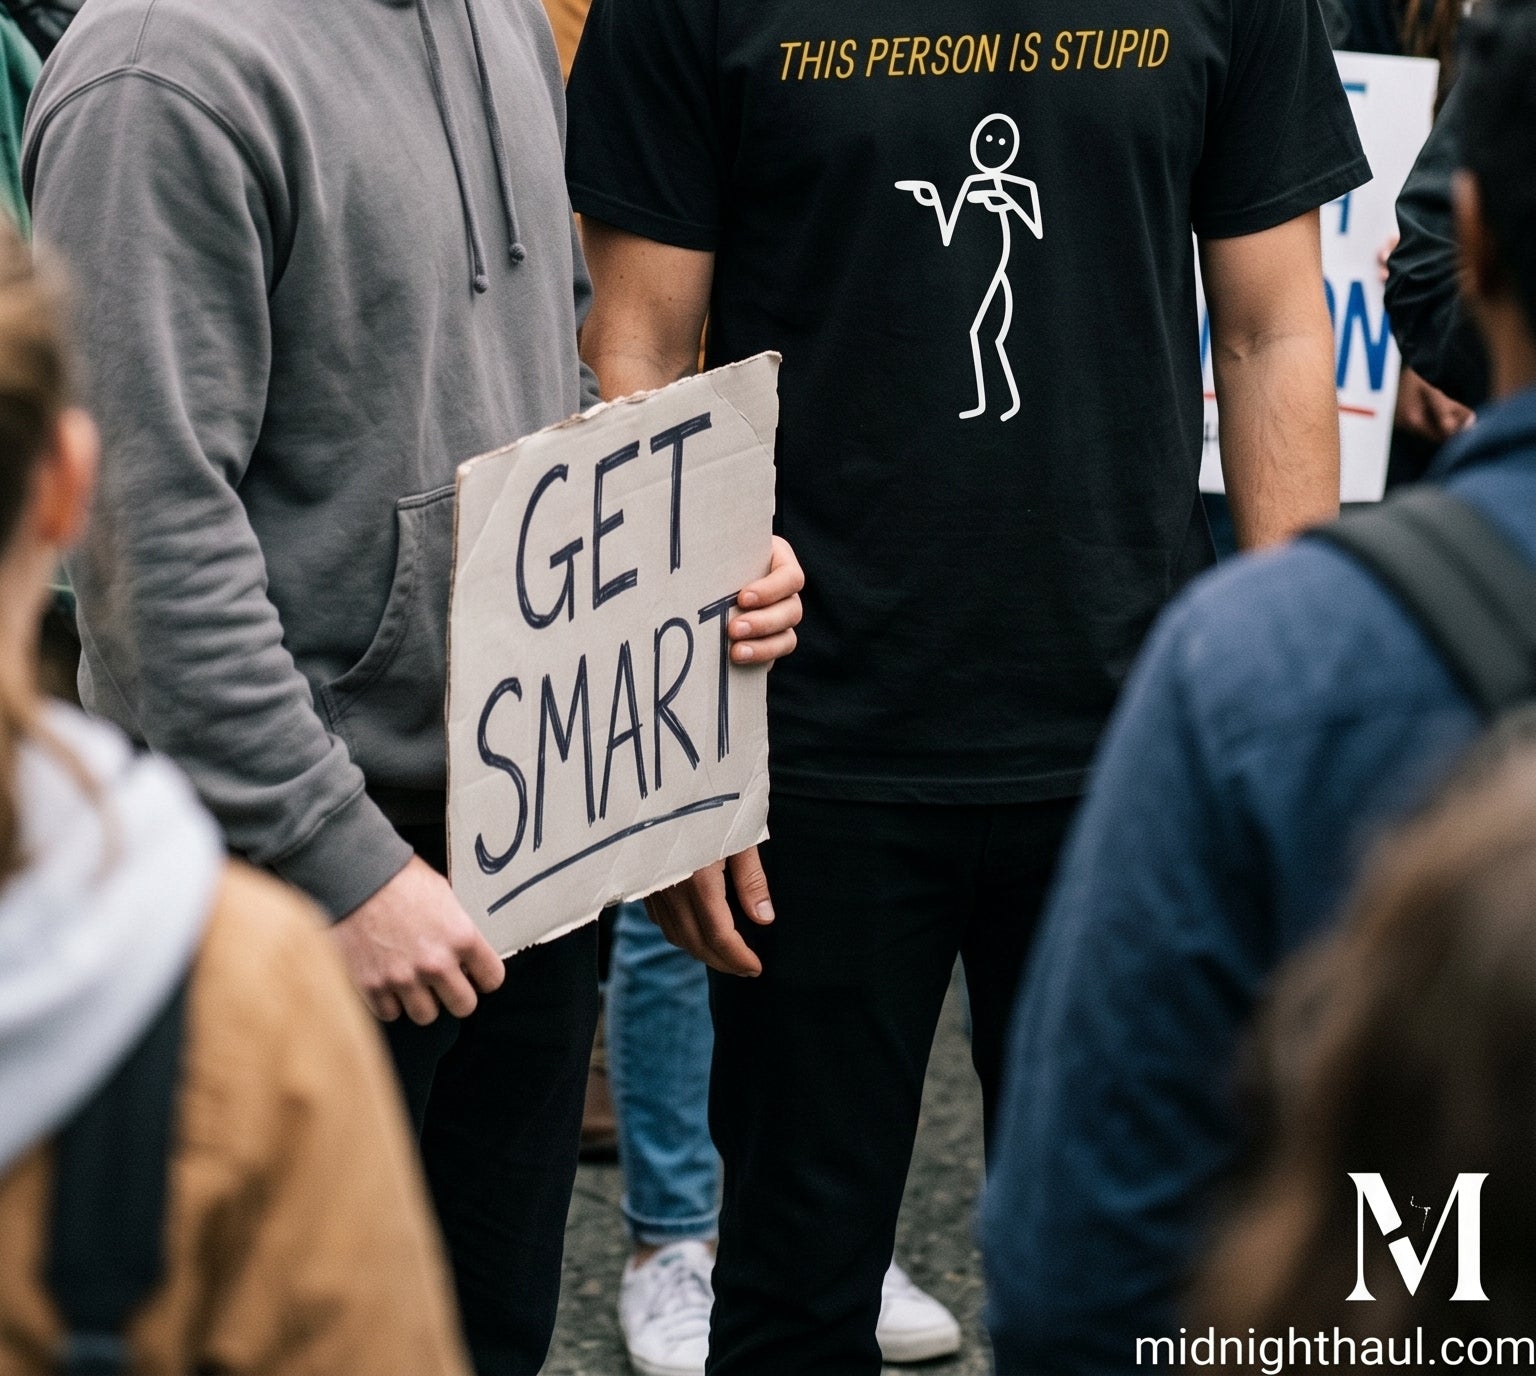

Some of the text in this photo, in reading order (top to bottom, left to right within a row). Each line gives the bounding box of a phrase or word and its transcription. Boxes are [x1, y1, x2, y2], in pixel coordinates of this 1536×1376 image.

[780, 28, 1170, 80] THIS PERSON IS STUPID
[514, 412, 711, 630] GET
[475, 592, 740, 875] SMART
